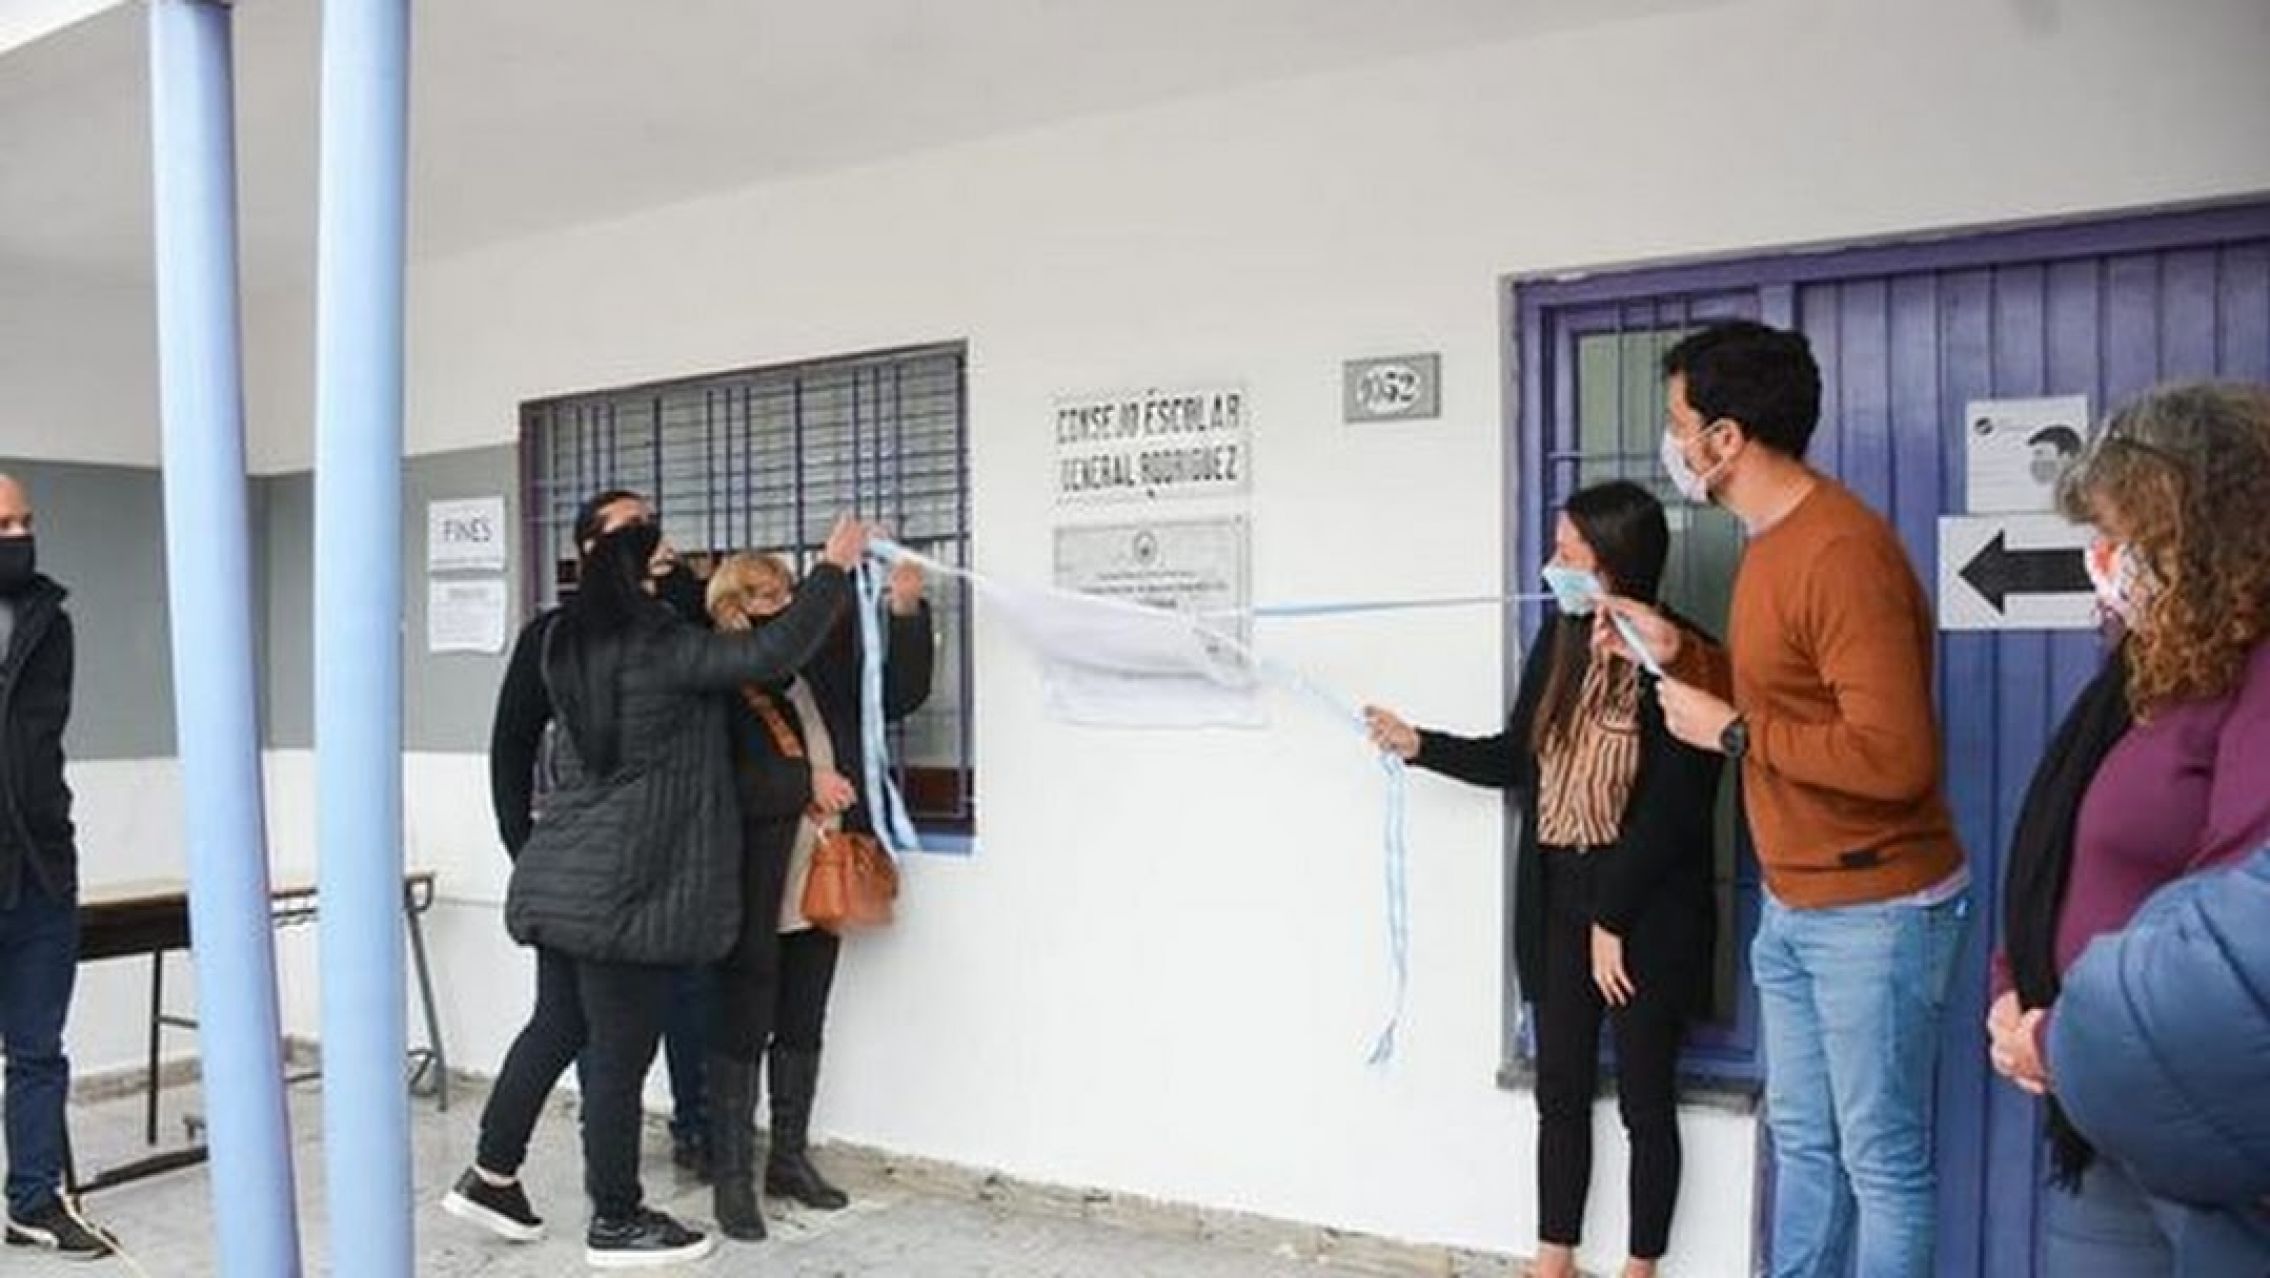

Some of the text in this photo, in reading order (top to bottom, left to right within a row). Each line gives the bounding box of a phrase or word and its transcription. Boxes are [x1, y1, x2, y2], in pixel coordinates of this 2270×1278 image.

[1057, 393, 1239, 443] CONSEJO ESCOLAR
[1062, 454, 1135, 492] GENERAL
